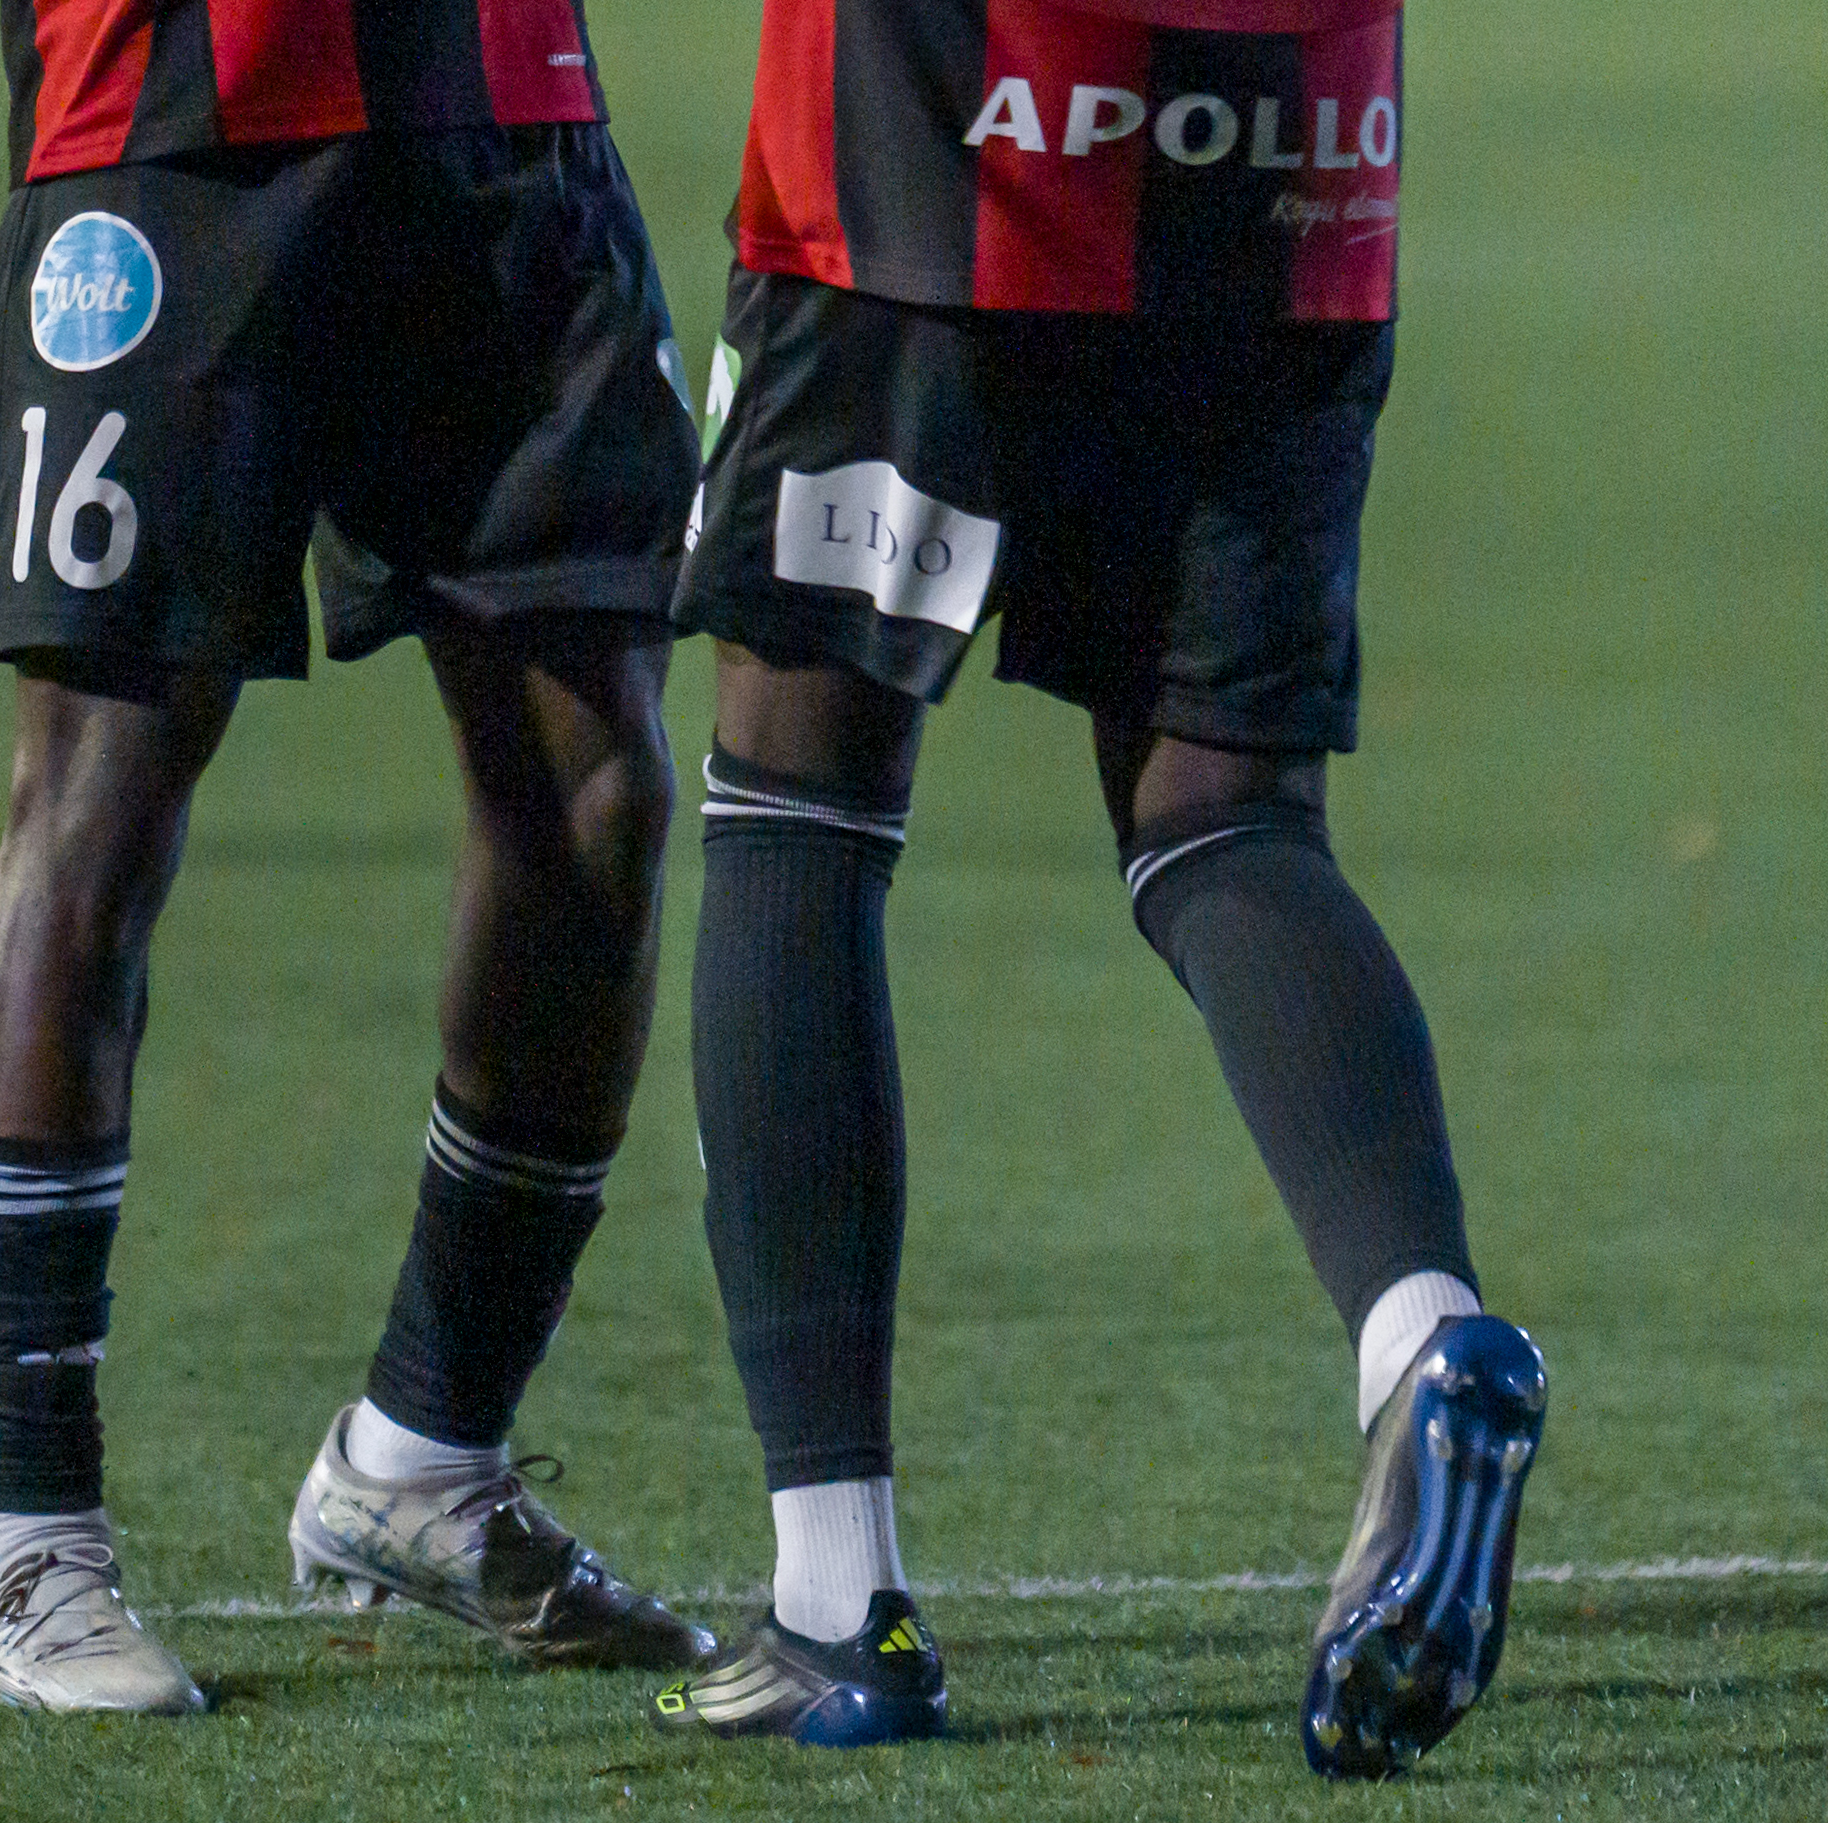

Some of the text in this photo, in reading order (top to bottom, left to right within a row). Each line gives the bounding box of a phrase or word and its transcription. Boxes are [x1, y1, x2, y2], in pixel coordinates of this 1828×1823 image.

[962, 76, 1396, 168] APOLLO
[47, 272, 135, 312] Wolt
[12, 406, 139, 589] 16
